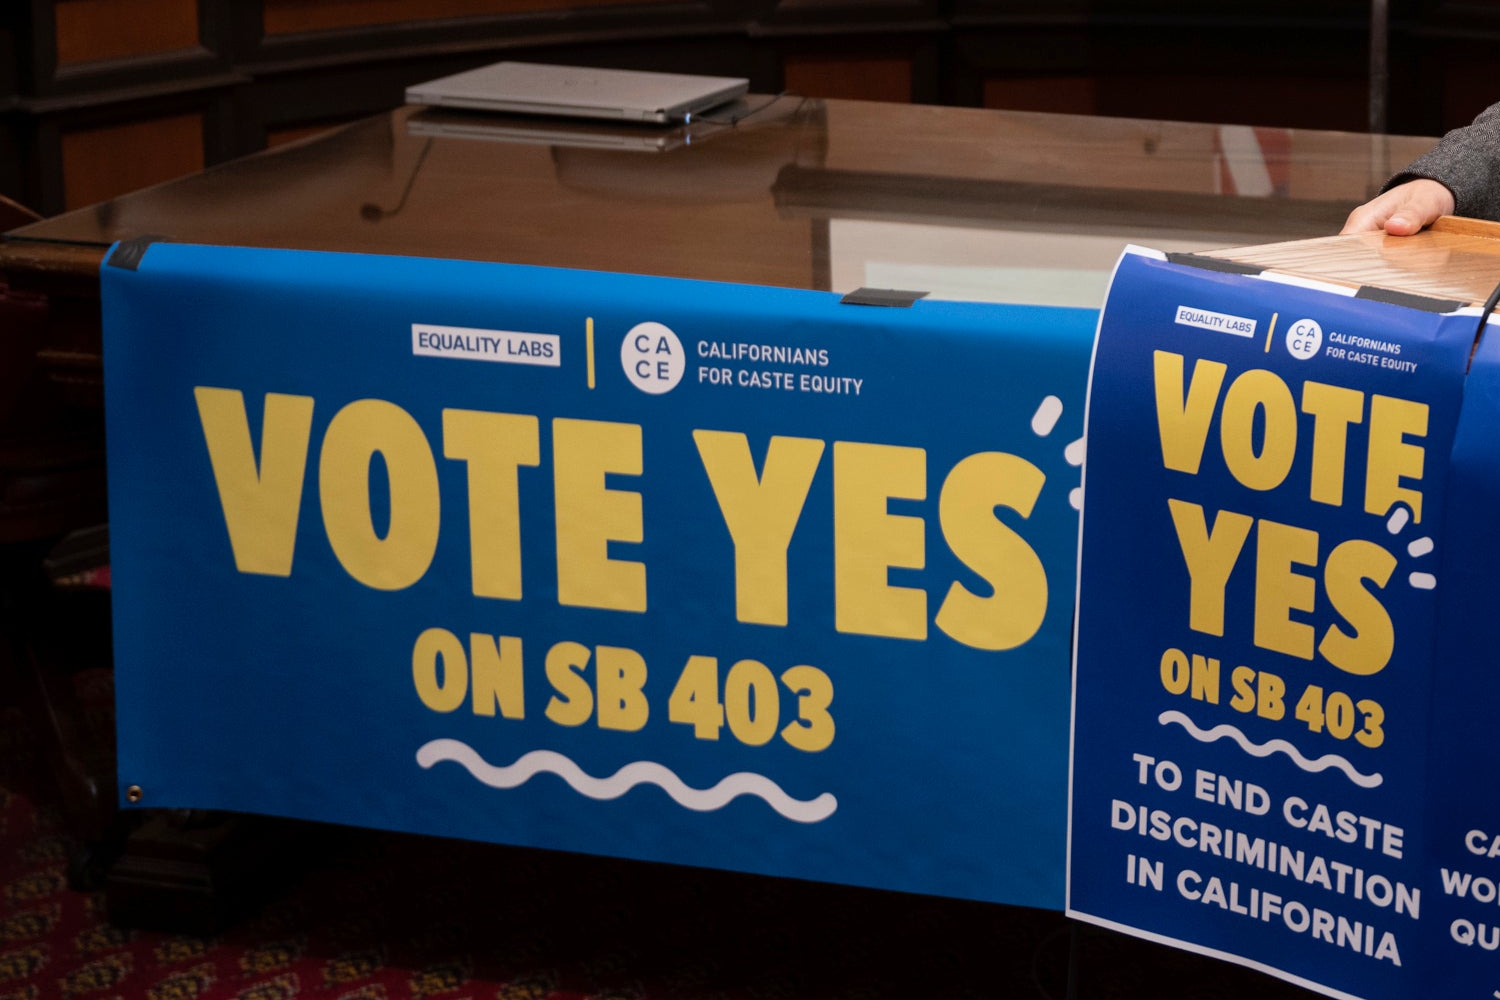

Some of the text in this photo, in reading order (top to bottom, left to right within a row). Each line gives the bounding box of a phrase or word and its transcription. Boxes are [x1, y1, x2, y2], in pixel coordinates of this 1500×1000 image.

[418, 332, 554, 358] EQUALITY LABS
[697, 340, 829, 367] CALIFORNIANS
[1179, 311, 1252, 333] EQUALITY LABS
[1326, 346, 1418, 374] FOR CASTE EQUITY
[1329, 332, 1401, 355] CALIFORNIANS
[698, 366, 863, 395] FOR CASTE EQUITY
[1153, 349, 1430, 525] VOTE
[194, 385, 1049, 651] VOTE YES
[1167, 498, 1398, 676] YES
[412, 627, 836, 752] ON SB 403
[1160, 648, 1385, 748] ON SB 403
[1133, 752, 1404, 860] TO END CASTE
[1111, 799, 1421, 920] DISCRIMINATION
[1126, 854, 1402, 967] IN CALIFORNIA
